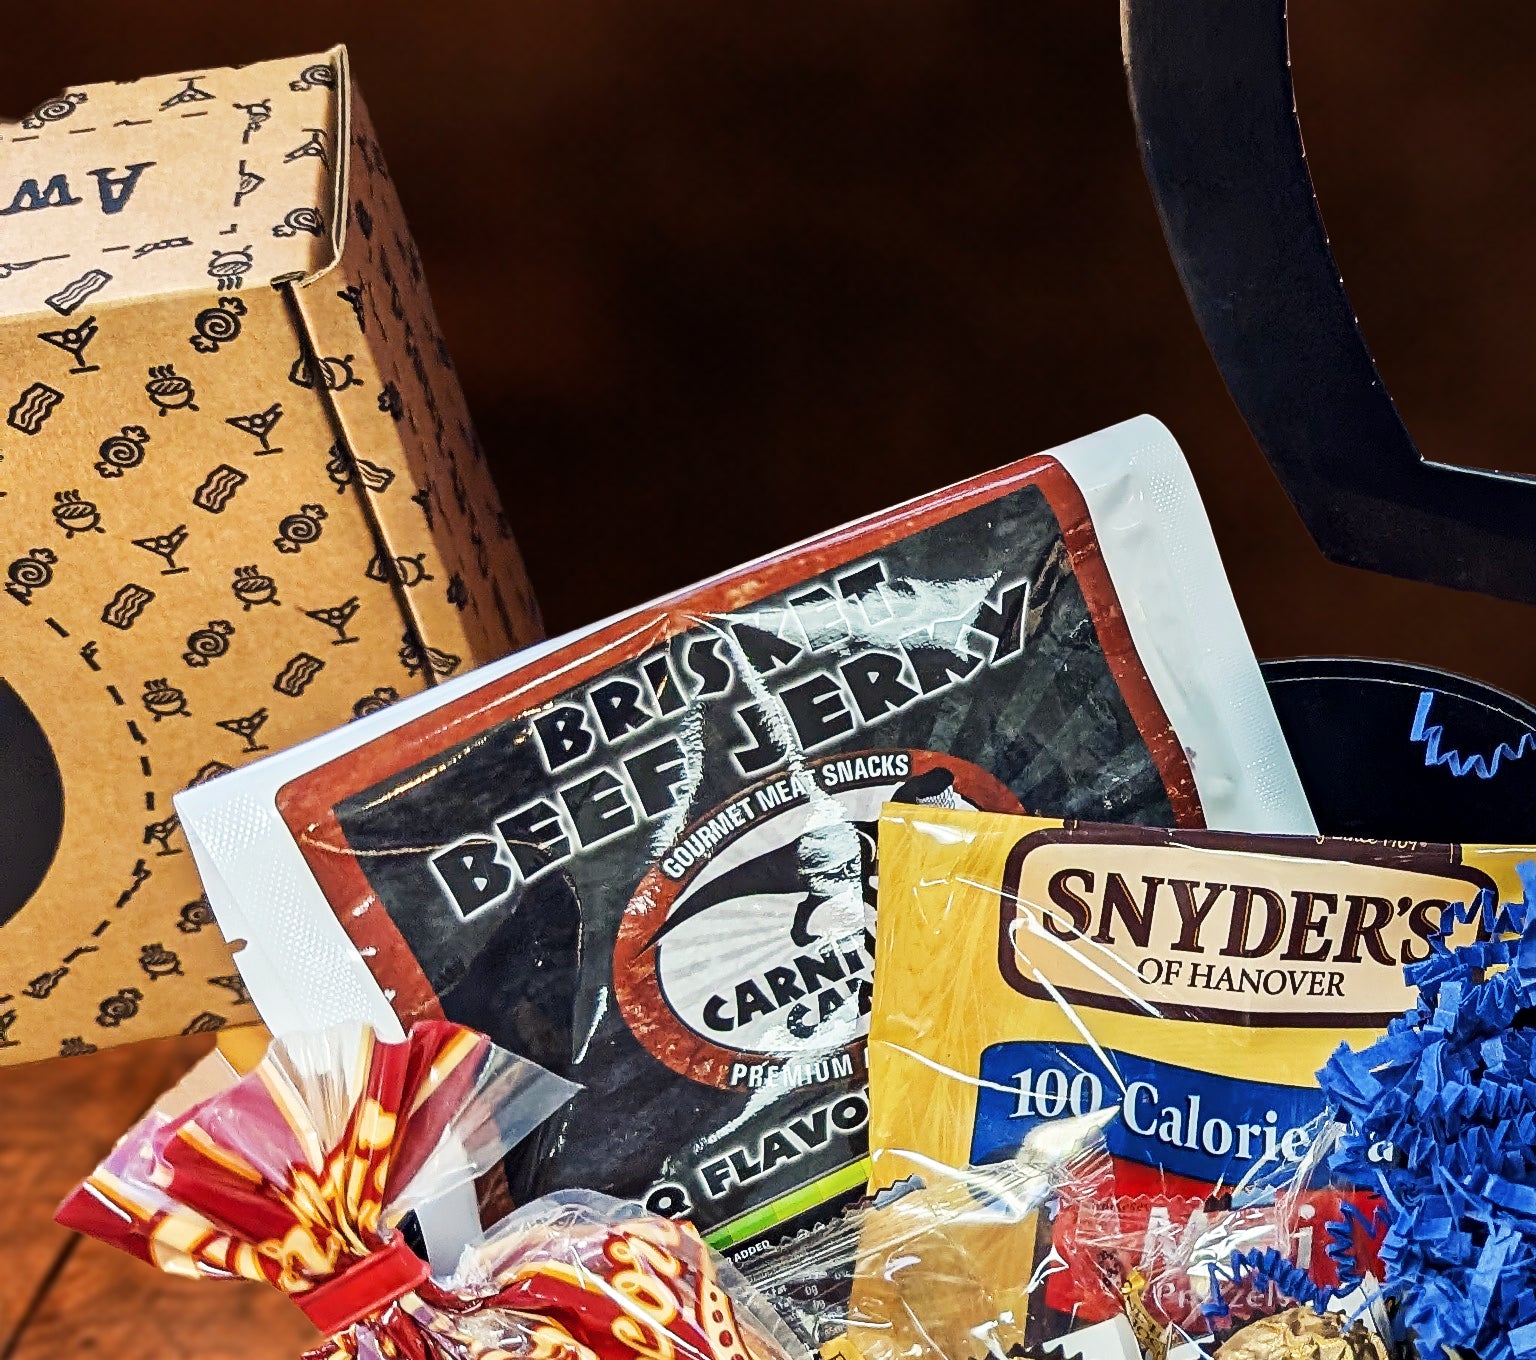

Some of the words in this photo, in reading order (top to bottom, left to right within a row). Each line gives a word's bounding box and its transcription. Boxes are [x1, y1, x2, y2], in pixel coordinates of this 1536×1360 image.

[430, 740, 692, 918] BEEF
[729, 581, 1029, 778] JERKY
[663, 800, 754, 878] GOURMET
[755, 770, 816, 812] MEAT
[822, 754, 909, 786] SNACKS
[1041, 868, 1452, 965] SNYDER'S
[1137, 958, 1181, 987] OF
[1188, 960, 1345, 997] HANOVER
[731, 1053, 853, 1087] PREMIUM
[1008, 1066, 1103, 1119] 100
[700, 1090, 869, 1196] FLAVO
[734, 1239, 771, 1263] ADDED
